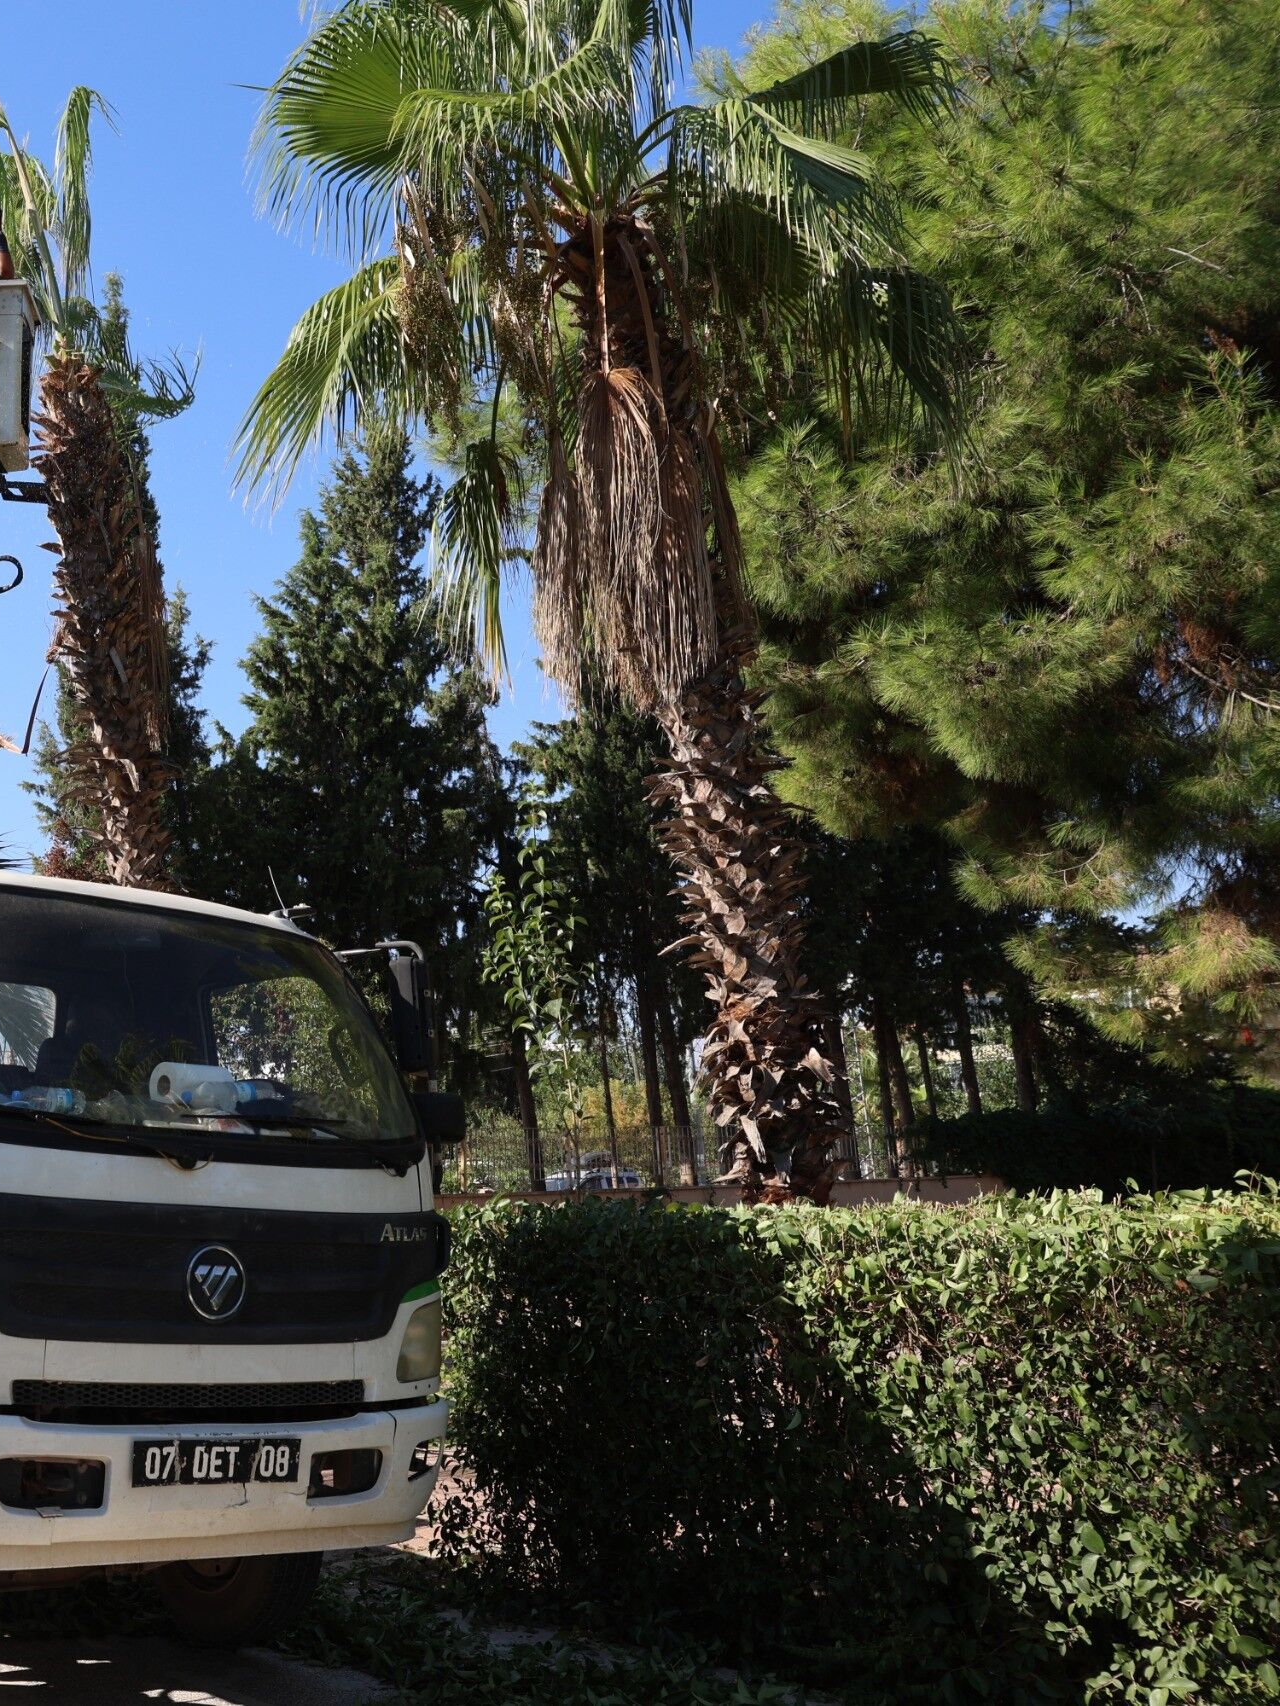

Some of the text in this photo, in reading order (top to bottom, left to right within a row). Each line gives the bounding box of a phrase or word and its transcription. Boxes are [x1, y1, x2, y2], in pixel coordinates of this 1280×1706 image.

[145, 1445, 290, 1480] 07 DET 08
